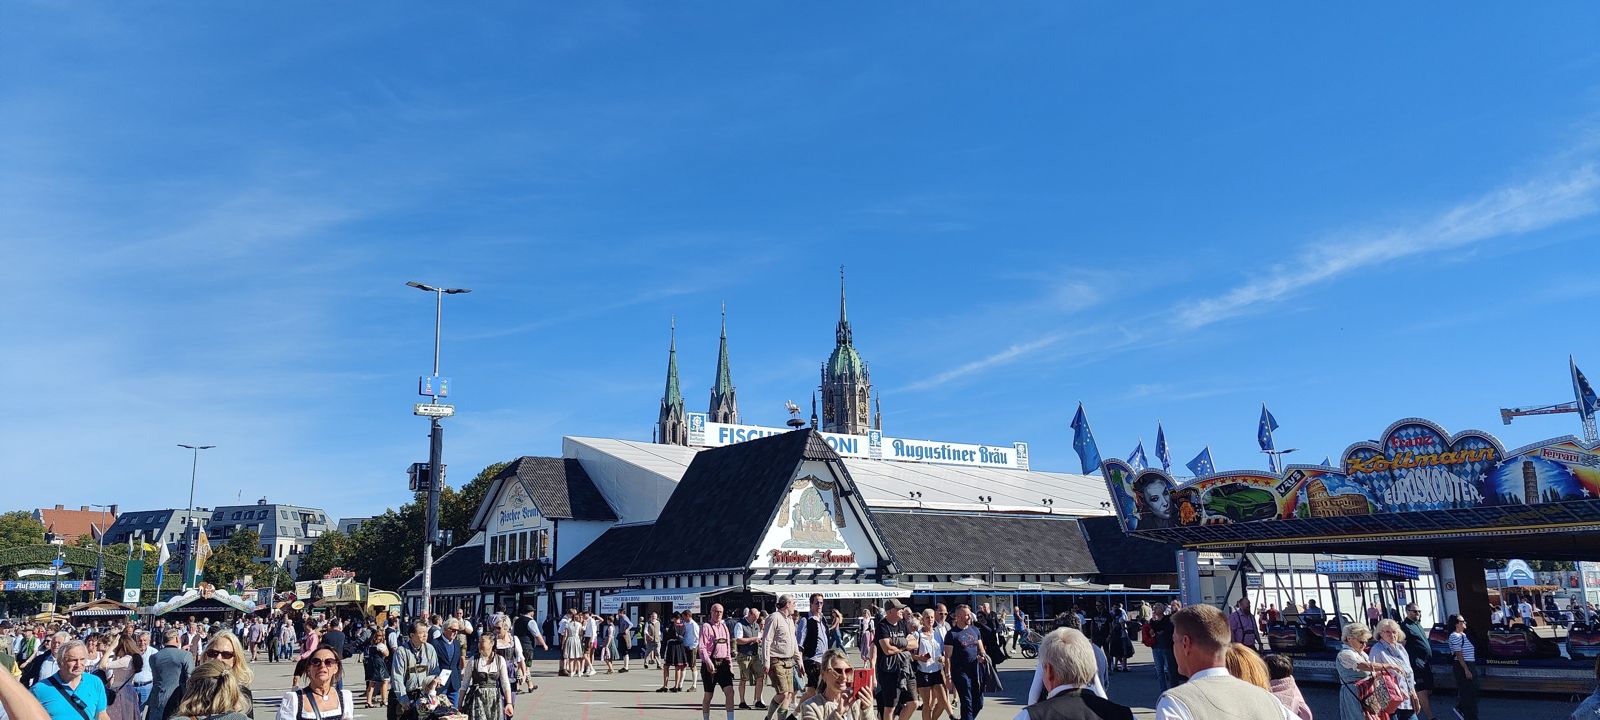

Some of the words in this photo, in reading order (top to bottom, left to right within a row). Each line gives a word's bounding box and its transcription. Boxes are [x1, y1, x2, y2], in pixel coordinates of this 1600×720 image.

[892, 439, 976, 462] Augustiner
[978, 446, 1008, 465] Bräu
[1391, 435, 1434, 448] Franz
[1346, 447, 1495, 475] Kollmann
[1542, 447, 1579, 463] Ferrari
[1383, 466, 1480, 505] EUROSKOOTER
[15, 582, 28, 590] Auf
[29, 581, 73, 589] Wiedehen
